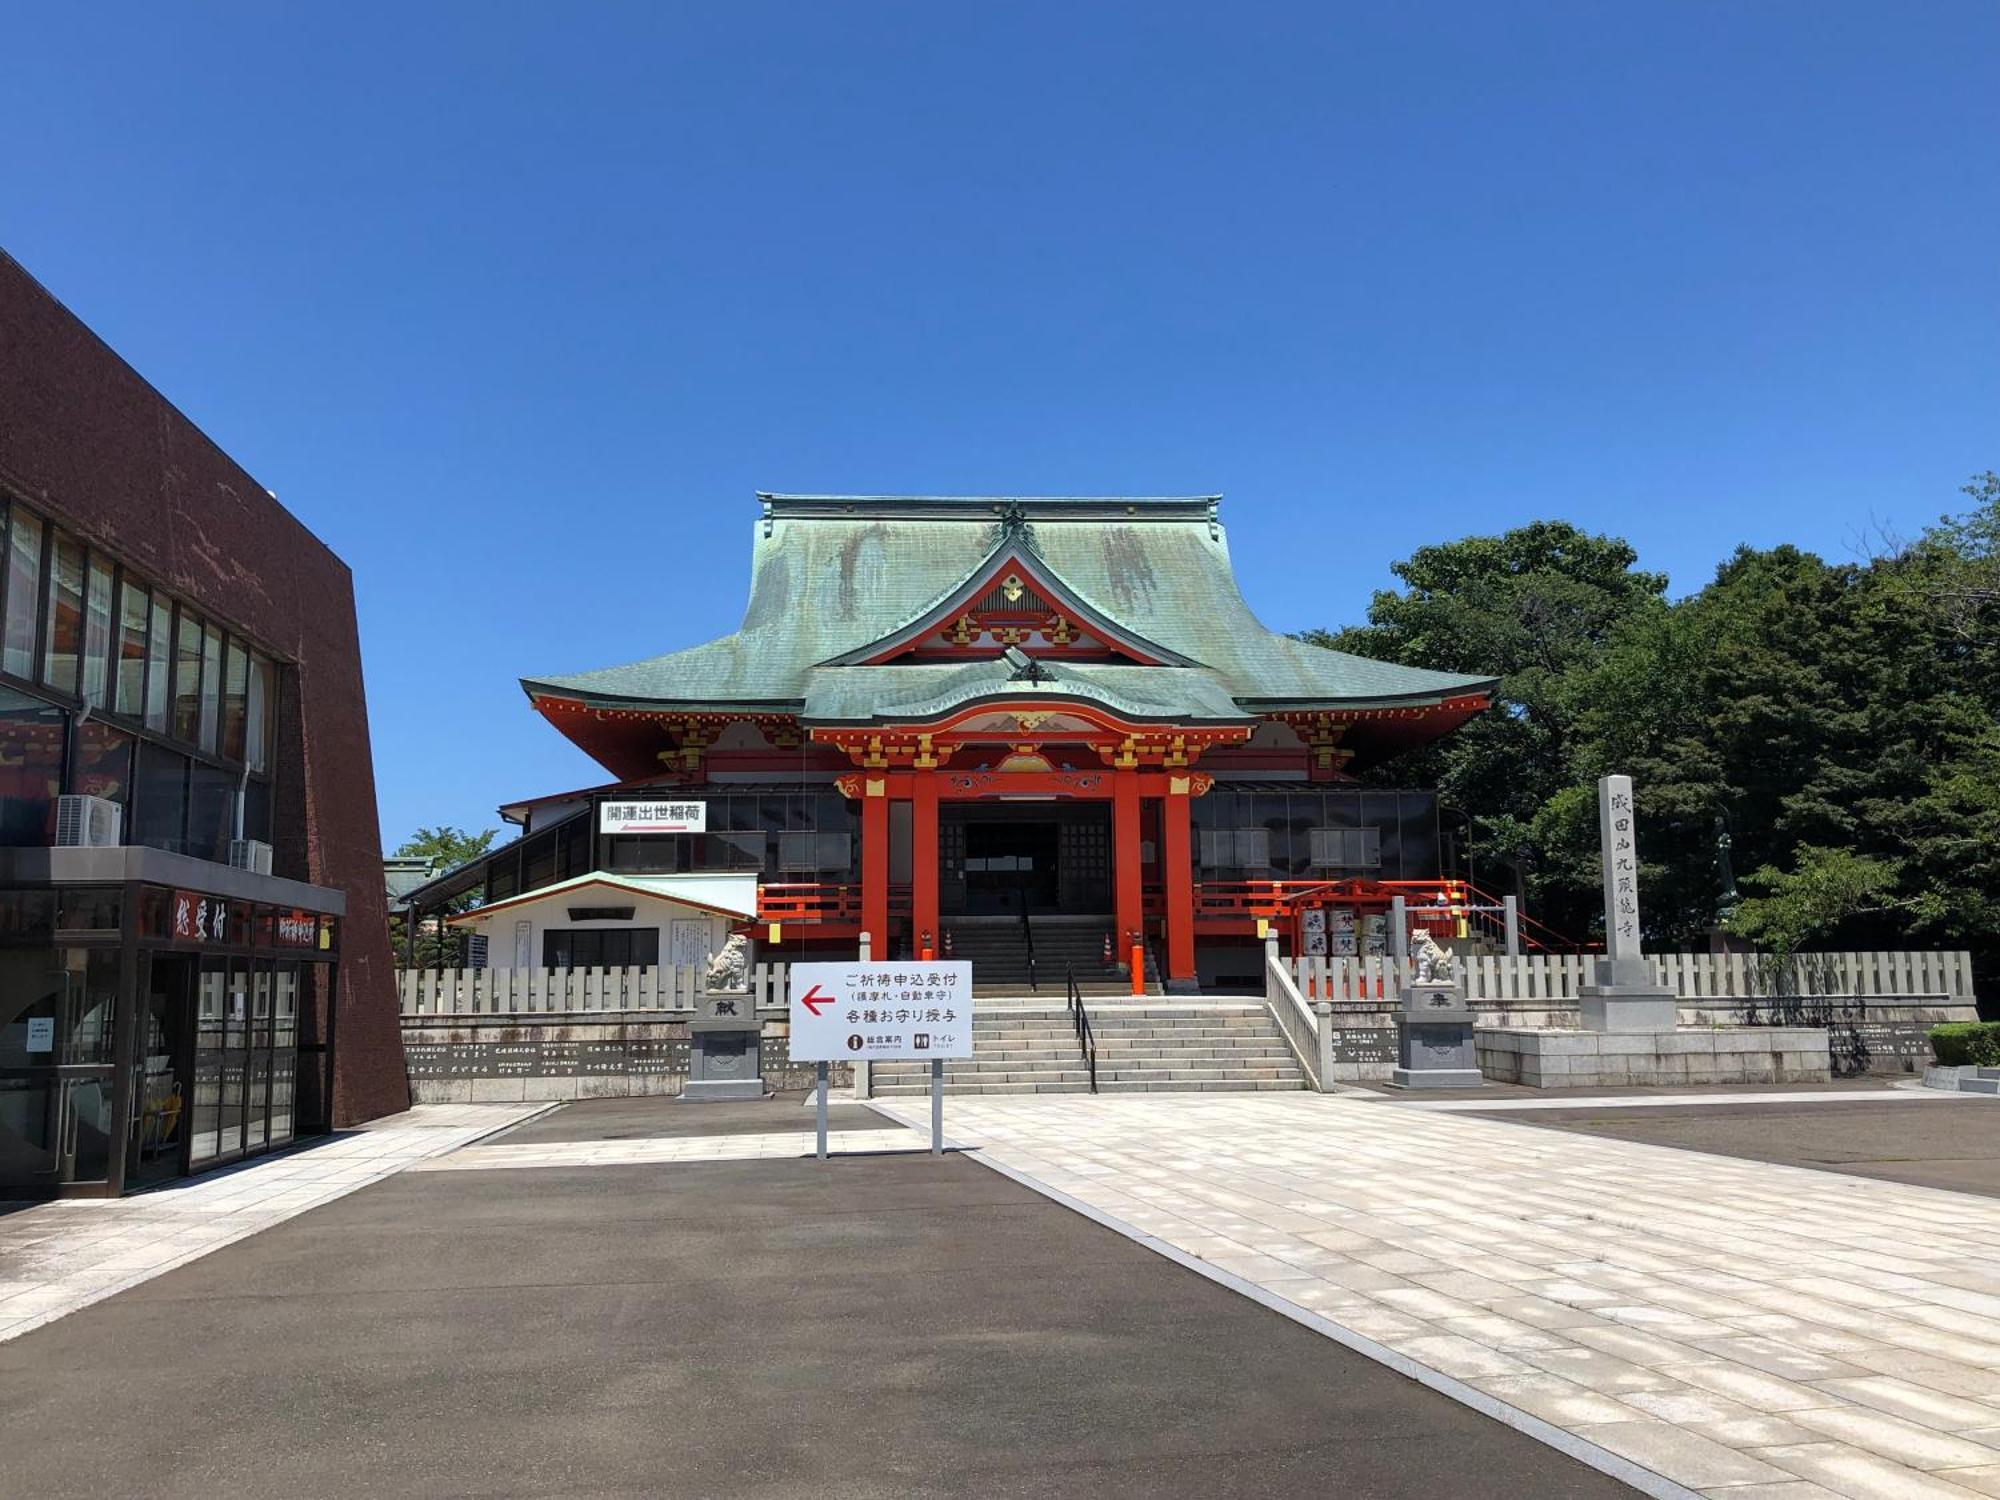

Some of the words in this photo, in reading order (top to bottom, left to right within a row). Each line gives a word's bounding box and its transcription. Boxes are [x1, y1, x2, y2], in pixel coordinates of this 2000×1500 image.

[607, 805, 700, 820] 開運出世稲荷
[846, 1009, 957, 1023] 各種お守り授与
[867, 1035, 902, 1043] 総合案内
[933, 1034, 955, 1042] トイレ
